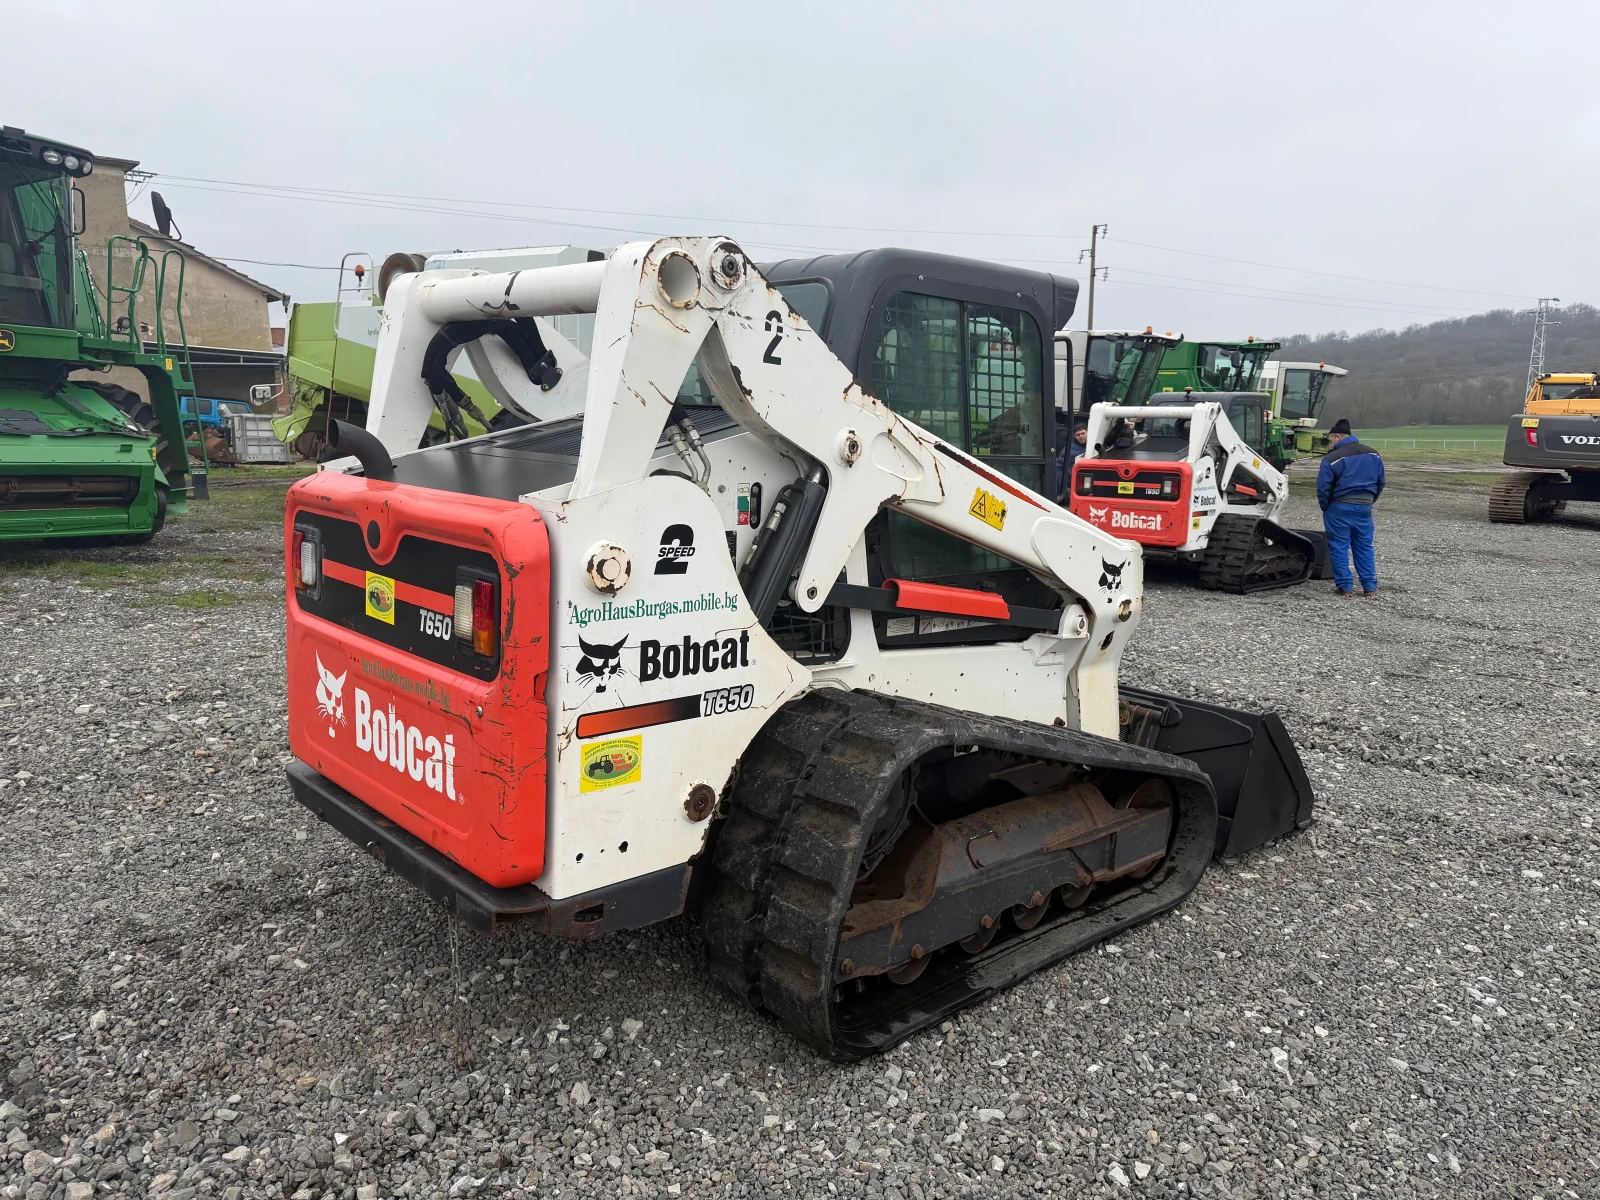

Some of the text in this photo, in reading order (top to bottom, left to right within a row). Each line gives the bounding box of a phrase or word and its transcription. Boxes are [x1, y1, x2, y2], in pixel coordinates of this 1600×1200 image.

[762, 310, 783, 366] 2
[1560, 435, 1600, 445] VOL
[1200, 495, 1216, 506] Bobcat
[1111, 510, 1162, 530] Bobcat
[654, 523, 694, 575] 2
[658, 546, 695, 557] SPEED
[419, 608, 452, 641] T650
[569, 592, 738, 628] AgroHausBurgas.mobile.bg
[639, 630, 750, 683] Bobcat
[702, 684, 754, 717] T650
[354, 686, 457, 802] Bobcat
